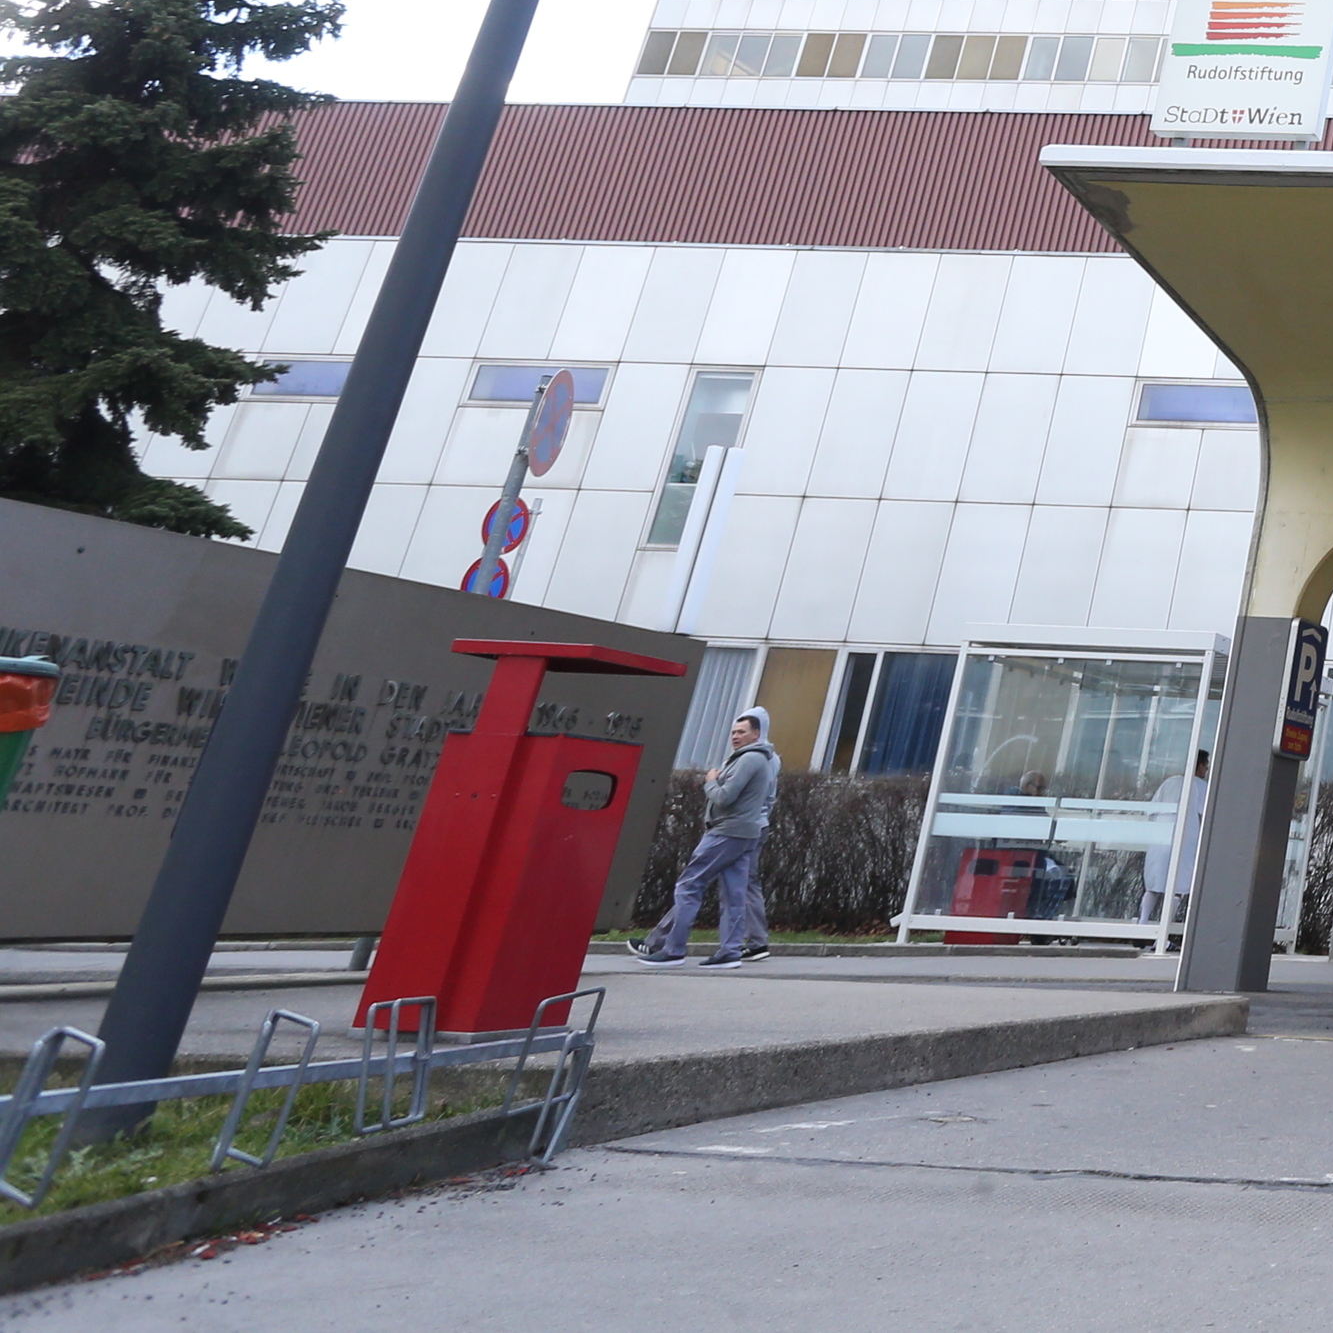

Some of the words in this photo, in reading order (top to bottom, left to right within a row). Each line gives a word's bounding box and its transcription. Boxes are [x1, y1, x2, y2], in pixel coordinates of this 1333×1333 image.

[1186, 65, 1304, 85] Rudolfstiftung
[1248, 106, 1303, 126] Wien
[1294, 642, 1318, 702] P
